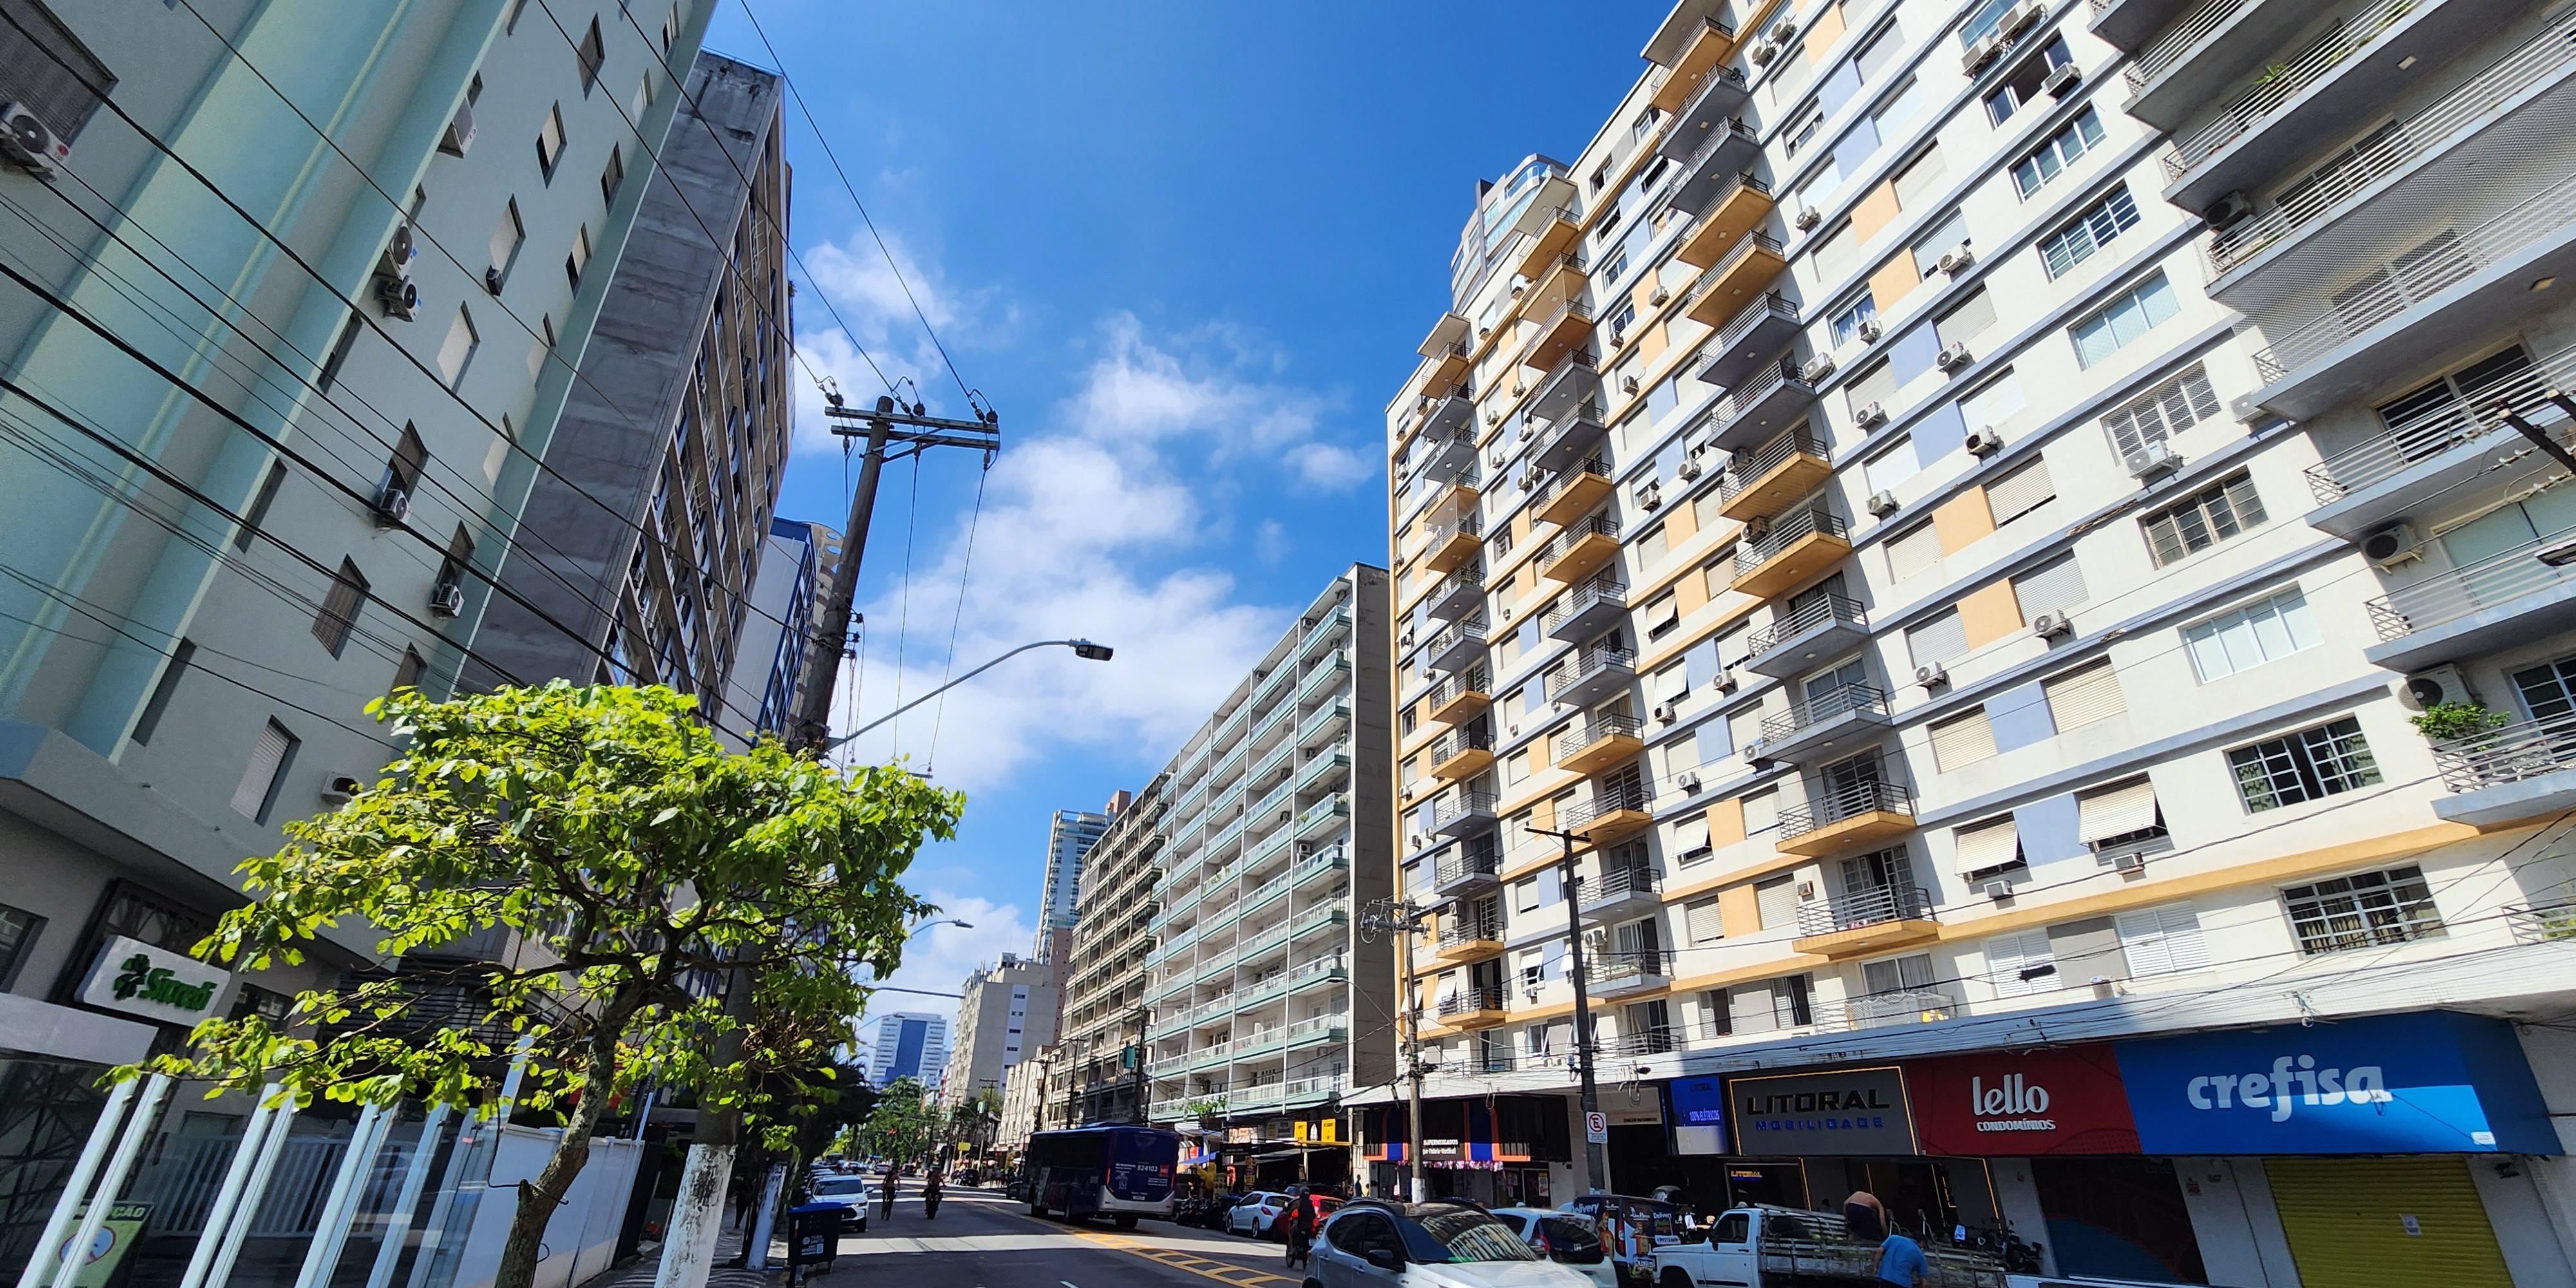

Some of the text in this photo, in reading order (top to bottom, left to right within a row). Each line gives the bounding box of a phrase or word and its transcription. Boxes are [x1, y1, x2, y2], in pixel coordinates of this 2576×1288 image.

[1973, 1073, 2049, 1115] lello
[2188, 1054, 2393, 1122] crefisa
[1746, 1089, 1891, 1115] LITORAL
[1689, 1107, 1720, 1122] 100% ELÉTRICOS
[1756, 1117, 1884, 1132] MOBILIDADE
[1976, 1118, 2056, 1132] CONDOMÍNIOS
